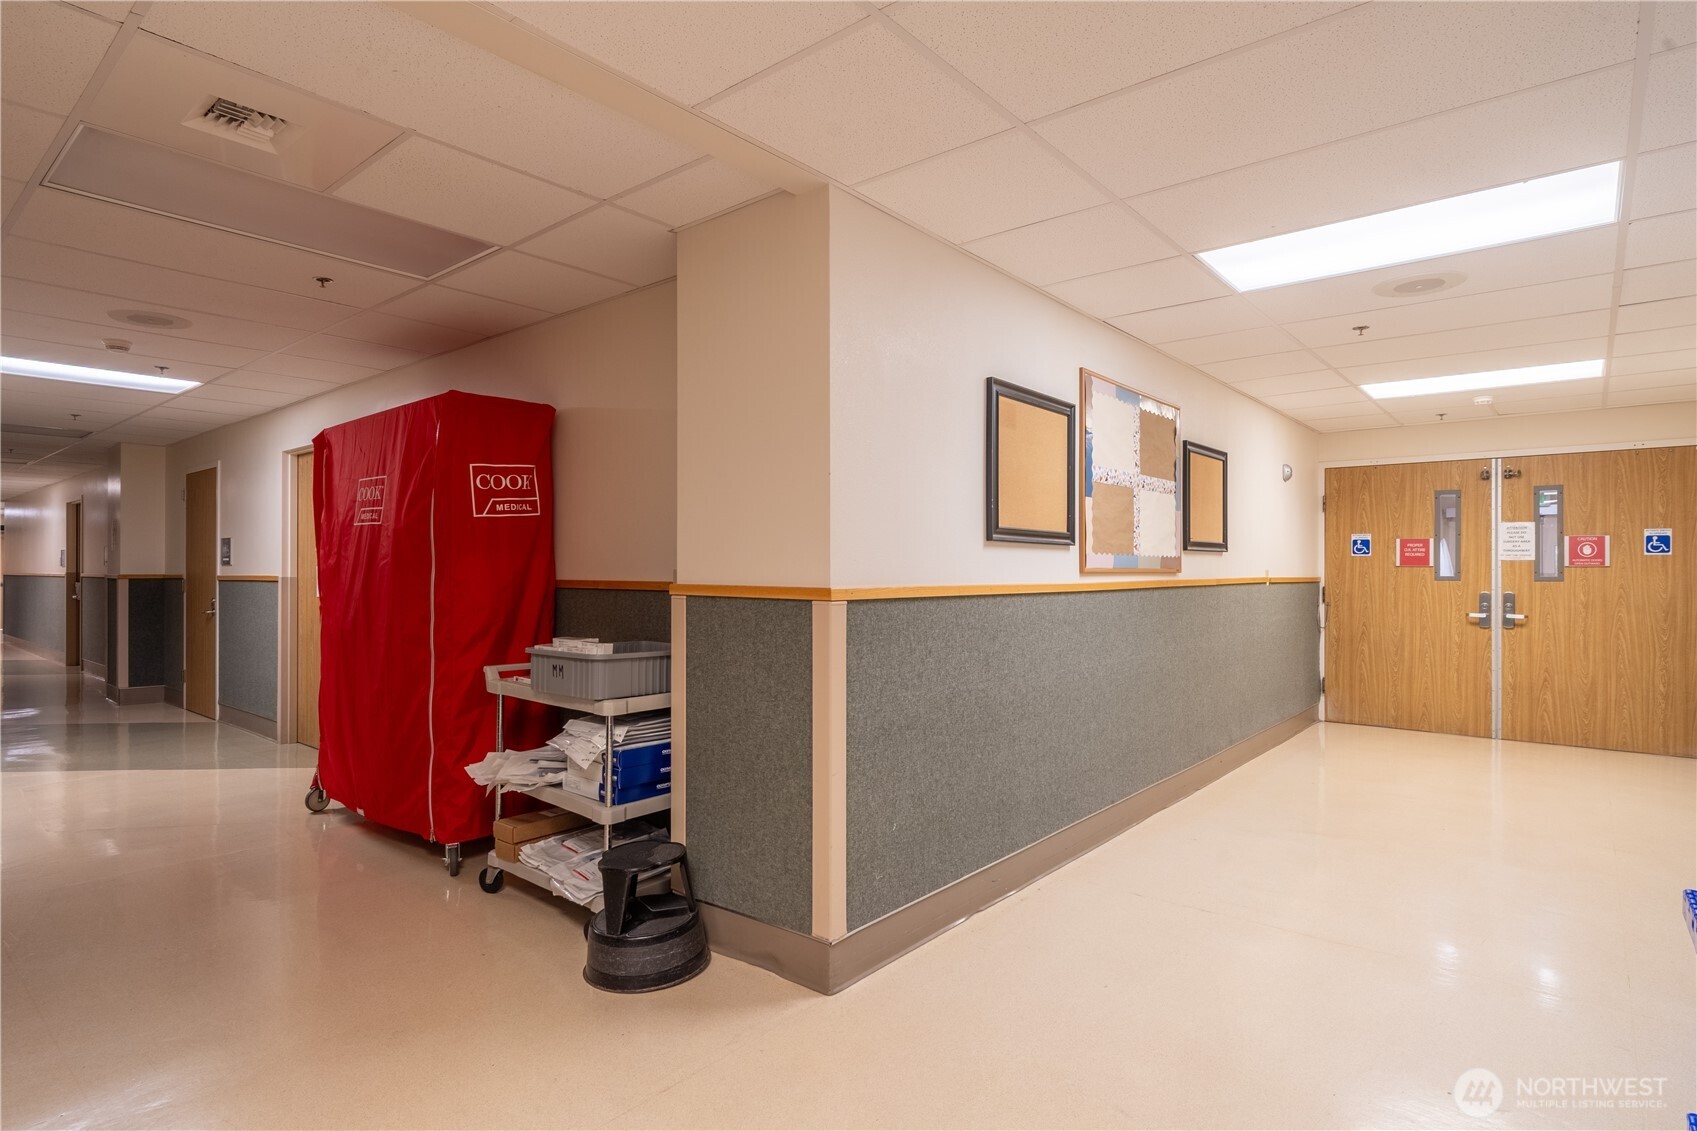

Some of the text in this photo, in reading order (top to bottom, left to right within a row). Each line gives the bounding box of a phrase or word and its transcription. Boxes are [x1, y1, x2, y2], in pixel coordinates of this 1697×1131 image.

[476, 474, 532, 490] COOK
[358, 486, 383, 501] COOK
[496, 503, 532, 511] MEDICAL
